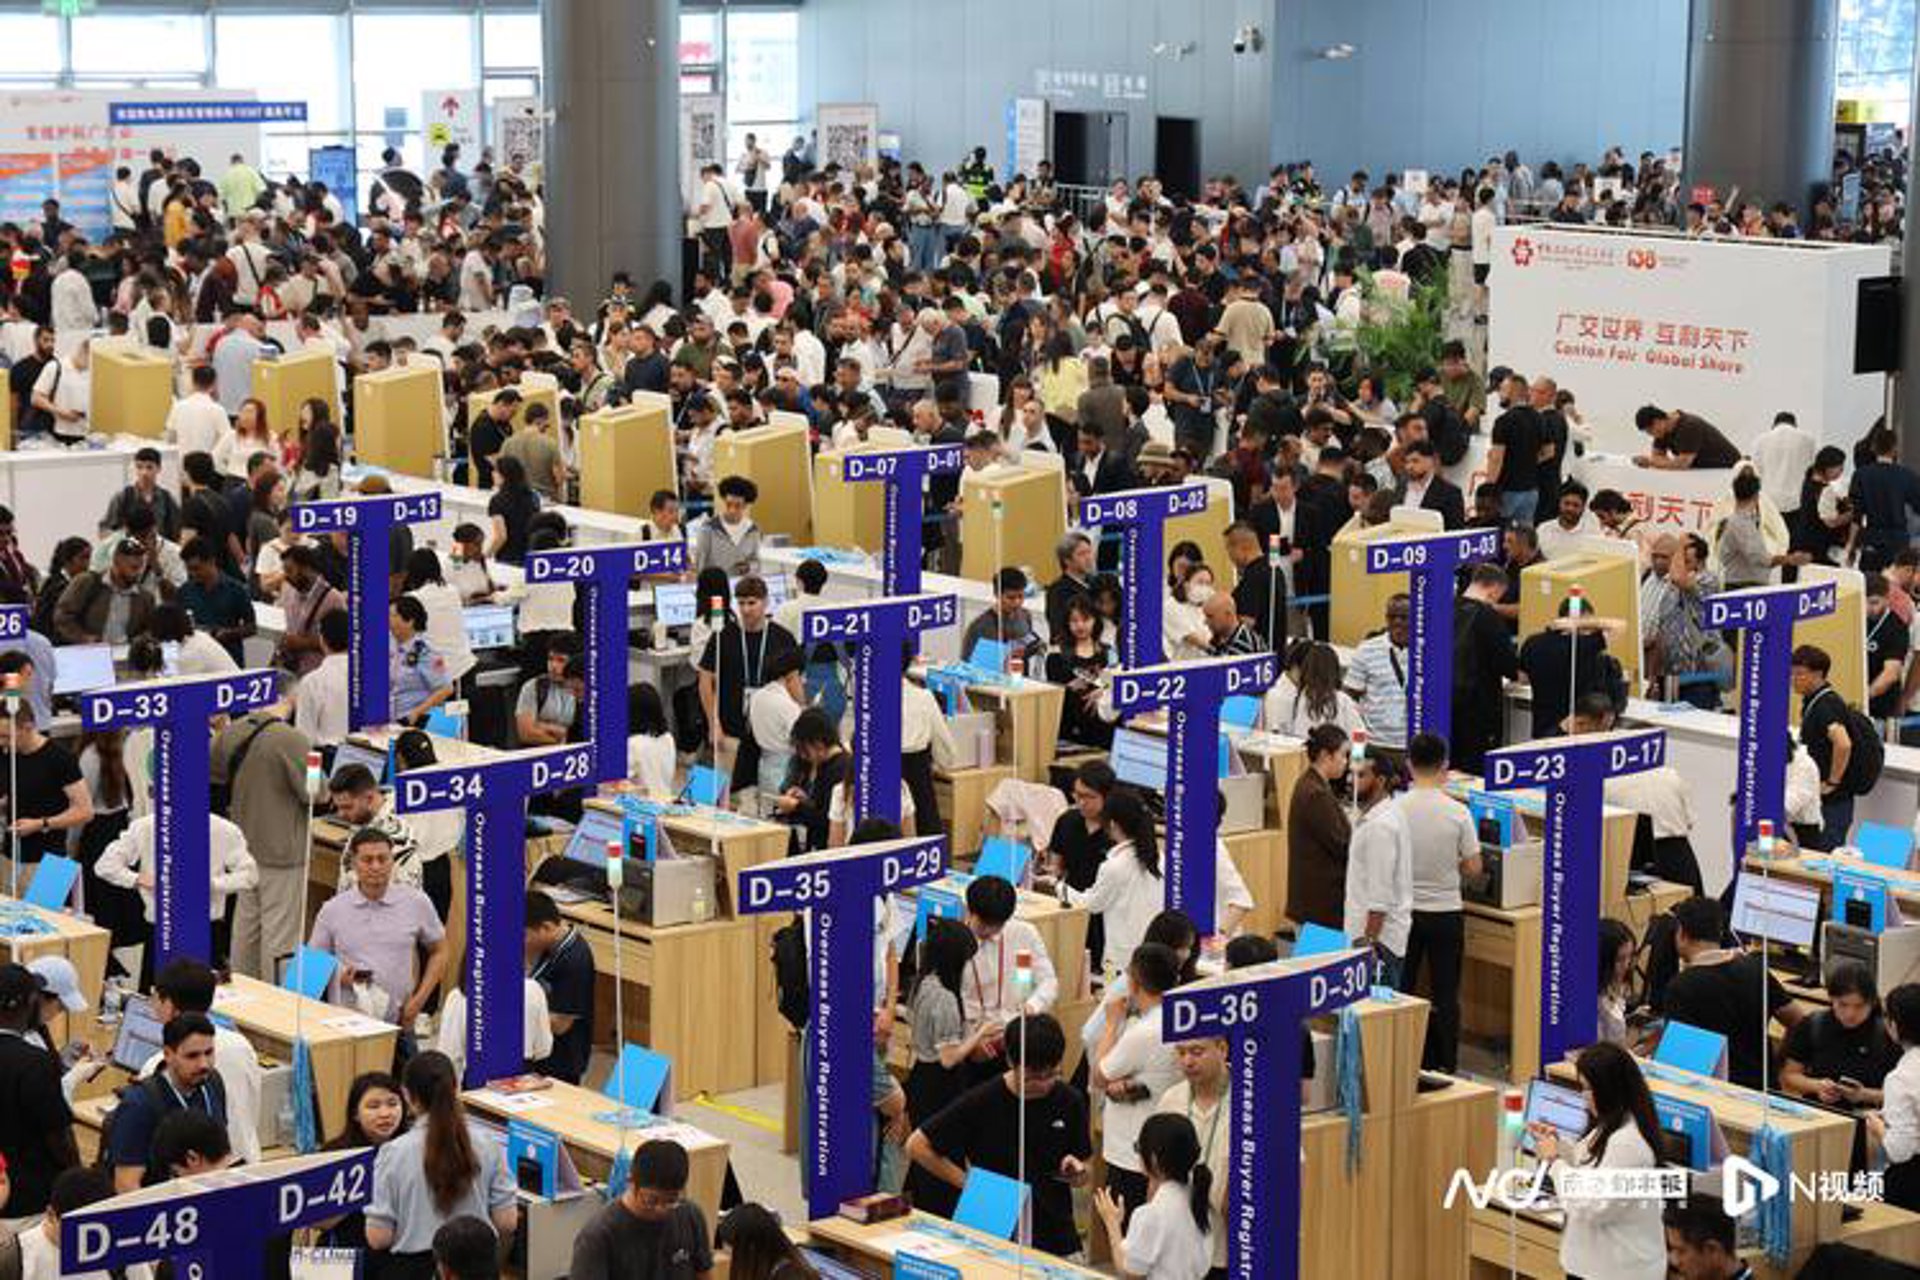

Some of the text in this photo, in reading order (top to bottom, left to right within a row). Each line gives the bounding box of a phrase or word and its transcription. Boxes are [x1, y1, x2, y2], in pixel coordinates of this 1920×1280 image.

[1556, 314, 1749, 352] 广交世界 互利天下
[1555, 340, 1744, 374] Canton Fair Global Share
[849, 457, 897, 477] D-07
[299, 507, 357, 528] D-19
[393, 498, 439, 521] D-13
[1087, 499, 1137, 520] D-08
[1169, 490, 1205, 513] D-02
[634, 542, 682, 571] D-14
[1373, 545, 1427, 569] D-09
[1459, 534, 1497, 559] D-03
[534, 556, 595, 579] D-20
[909, 601, 953, 628] D-15
[1712, 600, 1767, 625] D-10
[1799, 588, 1834, 615] D-04
[812, 612, 871, 638] D-21
[860, 645, 871, 704] Overseas
[1227, 665, 1274, 692] D-16
[1750, 632, 1764, 695] Overseas
[216, 677, 273, 708] D-27
[1121, 677, 1186, 702] D-22
[93, 694, 169, 723] D-33
[1747, 699, 1760, 738] Buyer
[859, 708, 871, 748] Buyer
[1175, 711, 1187, 779] Overseas
[161, 730, 172, 801] Overseas
[531, 752, 590, 788] D-28
[1494, 754, 1566, 785] D-23
[1611, 739, 1663, 771] D-17
[406, 773, 484, 807] D-34
[160, 806, 172, 851] Buyer
[1552, 793, 1566, 867] Overseas
[474, 813, 486, 889] Overseas
[883, 847, 941, 886] D-29
[749, 869, 830, 907] D-35
[1550, 872, 1565, 919] Buyer
[473, 895, 485, 942] Buyer
[1310, 961, 1367, 1008] D-30
[1173, 990, 1259, 1033] D-36
[817, 913, 833, 1177] Overseas Buyer Registration
[1242, 1038, 1258, 1134] Overseas
[1240, 1139, 1256, 1200] Buyer
[279, 1163, 365, 1224] D-42
[77, 1206, 199, 1264] D-48
